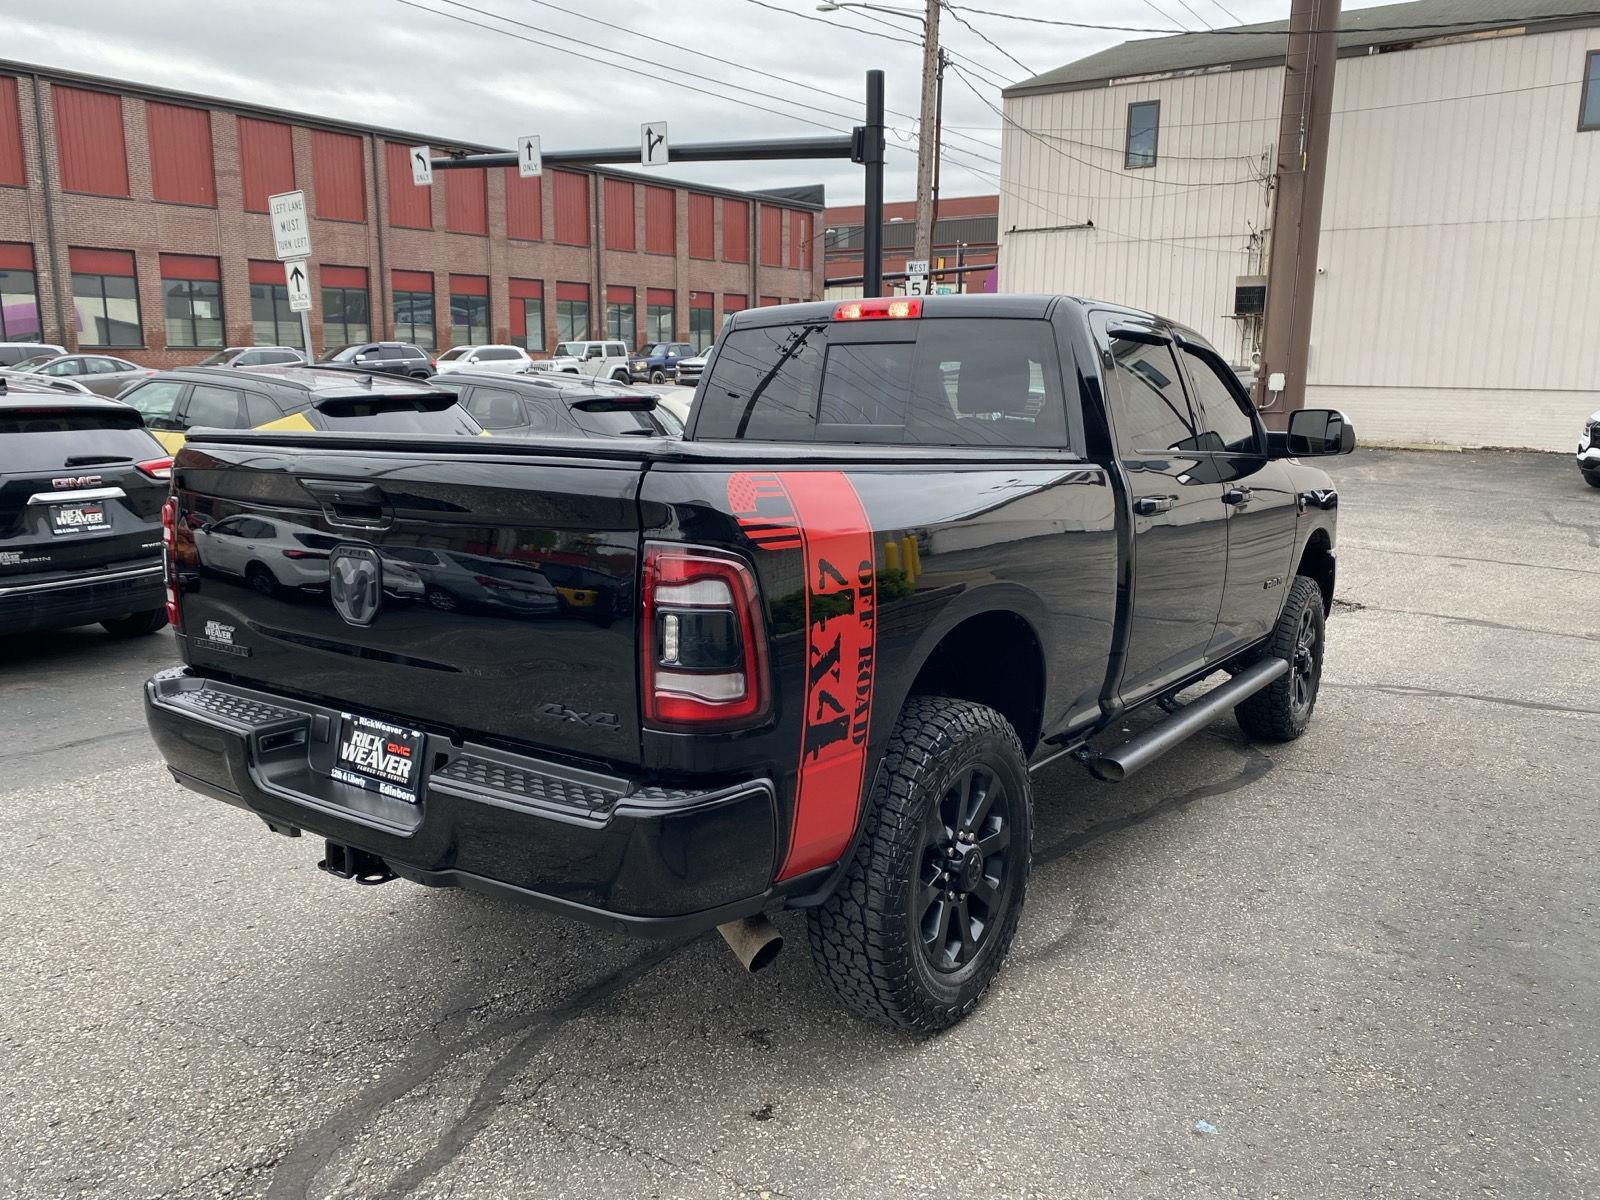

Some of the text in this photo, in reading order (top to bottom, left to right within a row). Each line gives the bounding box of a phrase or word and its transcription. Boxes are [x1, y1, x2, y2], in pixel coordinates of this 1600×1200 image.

[522, 163, 538, 172] ONLY
[416, 174, 430, 182] ONLY
[273, 200, 303, 214] LEFT LANE
[280, 218, 299, 232] MUST
[278, 237, 307, 250] TURN LEFT
[908, 263, 926, 272] WEST
[911, 282, 921, 296] 5
[52, 475, 102, 489] GMC
[56, 511, 103, 526] WEAVER
[205, 626, 232, 640] WEAVER
[852, 559, 874, 745] OFF ROAD
[359, 716, 402, 735] RickWeaver
[351, 730, 385, 752] RICK
[387, 743, 411, 757] GMC
[341, 742, 412, 778] WEAVER
[347, 773, 366, 788] Liberty
[356, 764, 408, 785] FAMOUS FOR SERVICE
[379, 783, 416, 803] Edinboro
